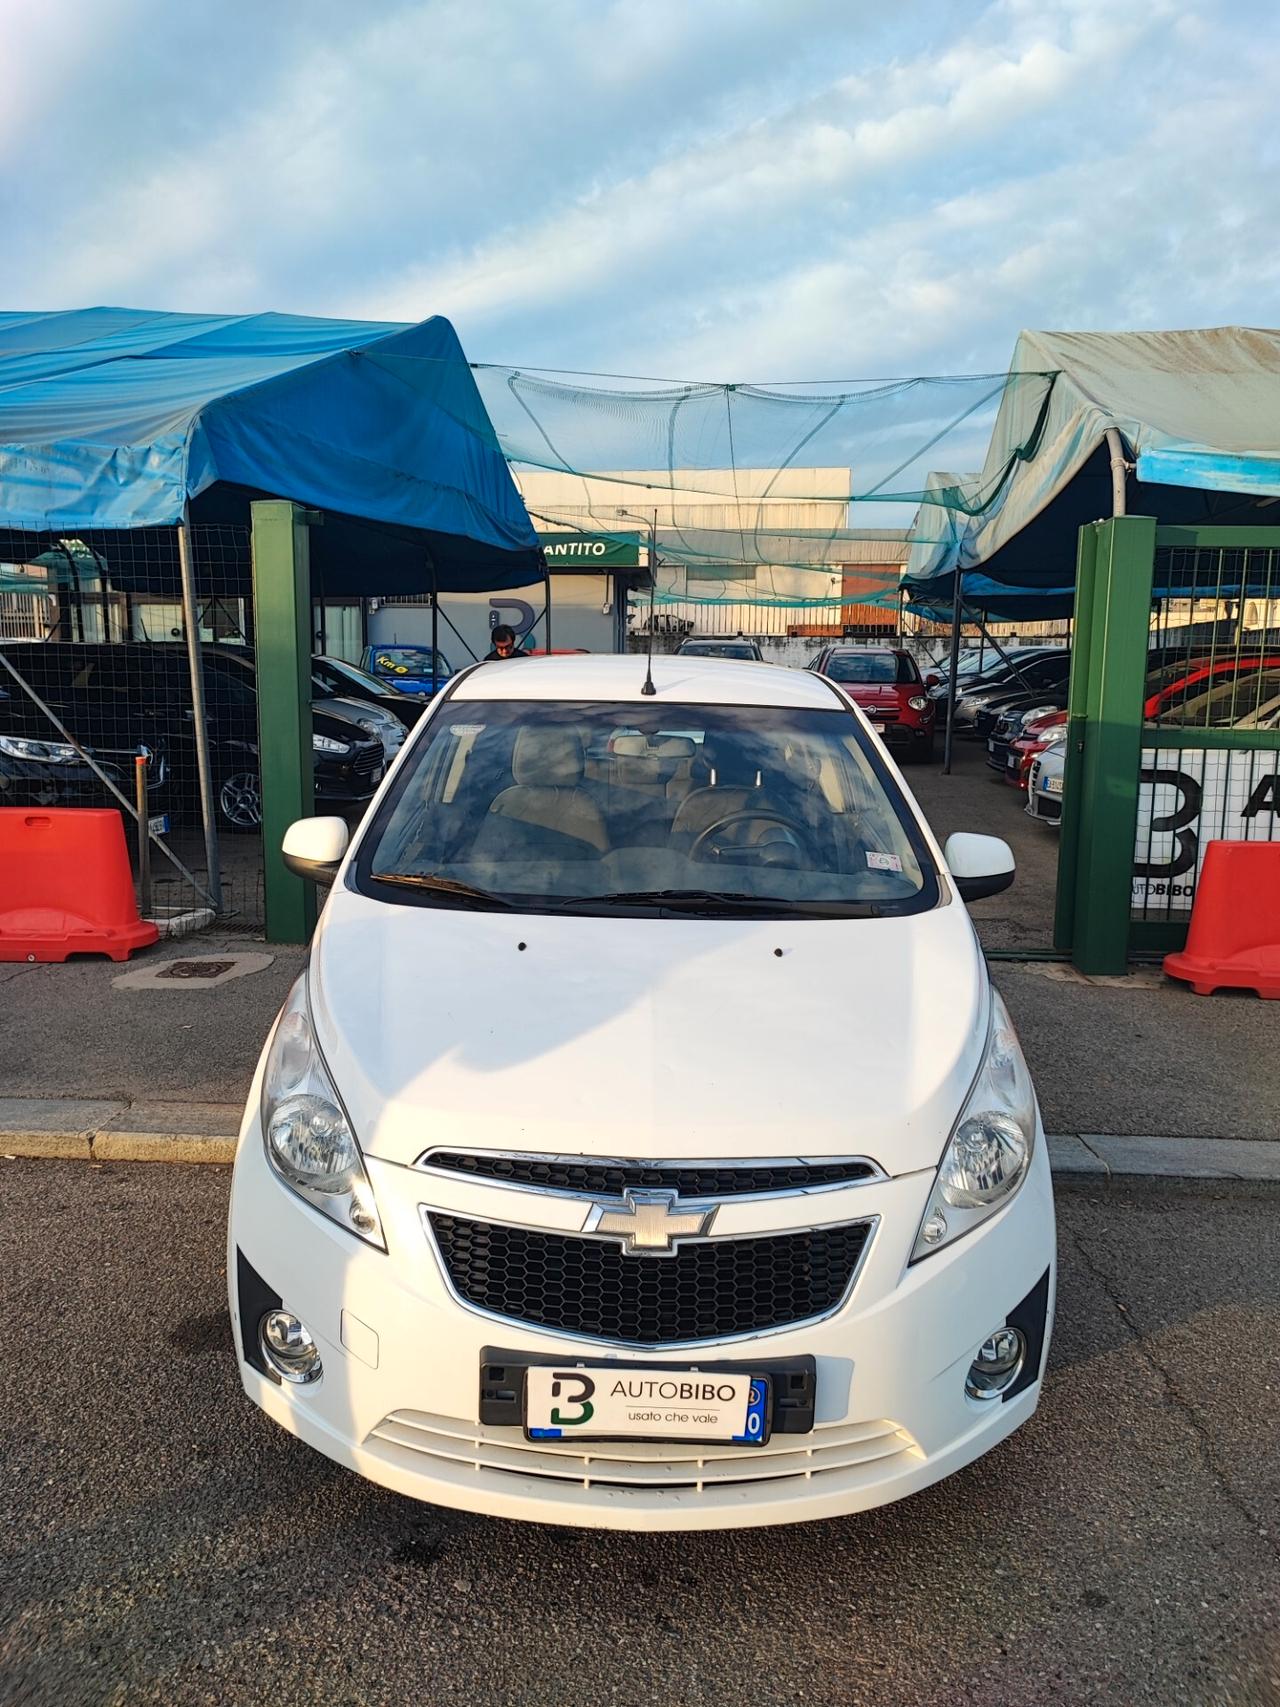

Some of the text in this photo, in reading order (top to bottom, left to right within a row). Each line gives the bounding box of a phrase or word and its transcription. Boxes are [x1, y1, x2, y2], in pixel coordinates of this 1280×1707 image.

[610, 1380, 736, 1402] AUTOBIBO
[628, 1410, 719, 1424] usato che vale
